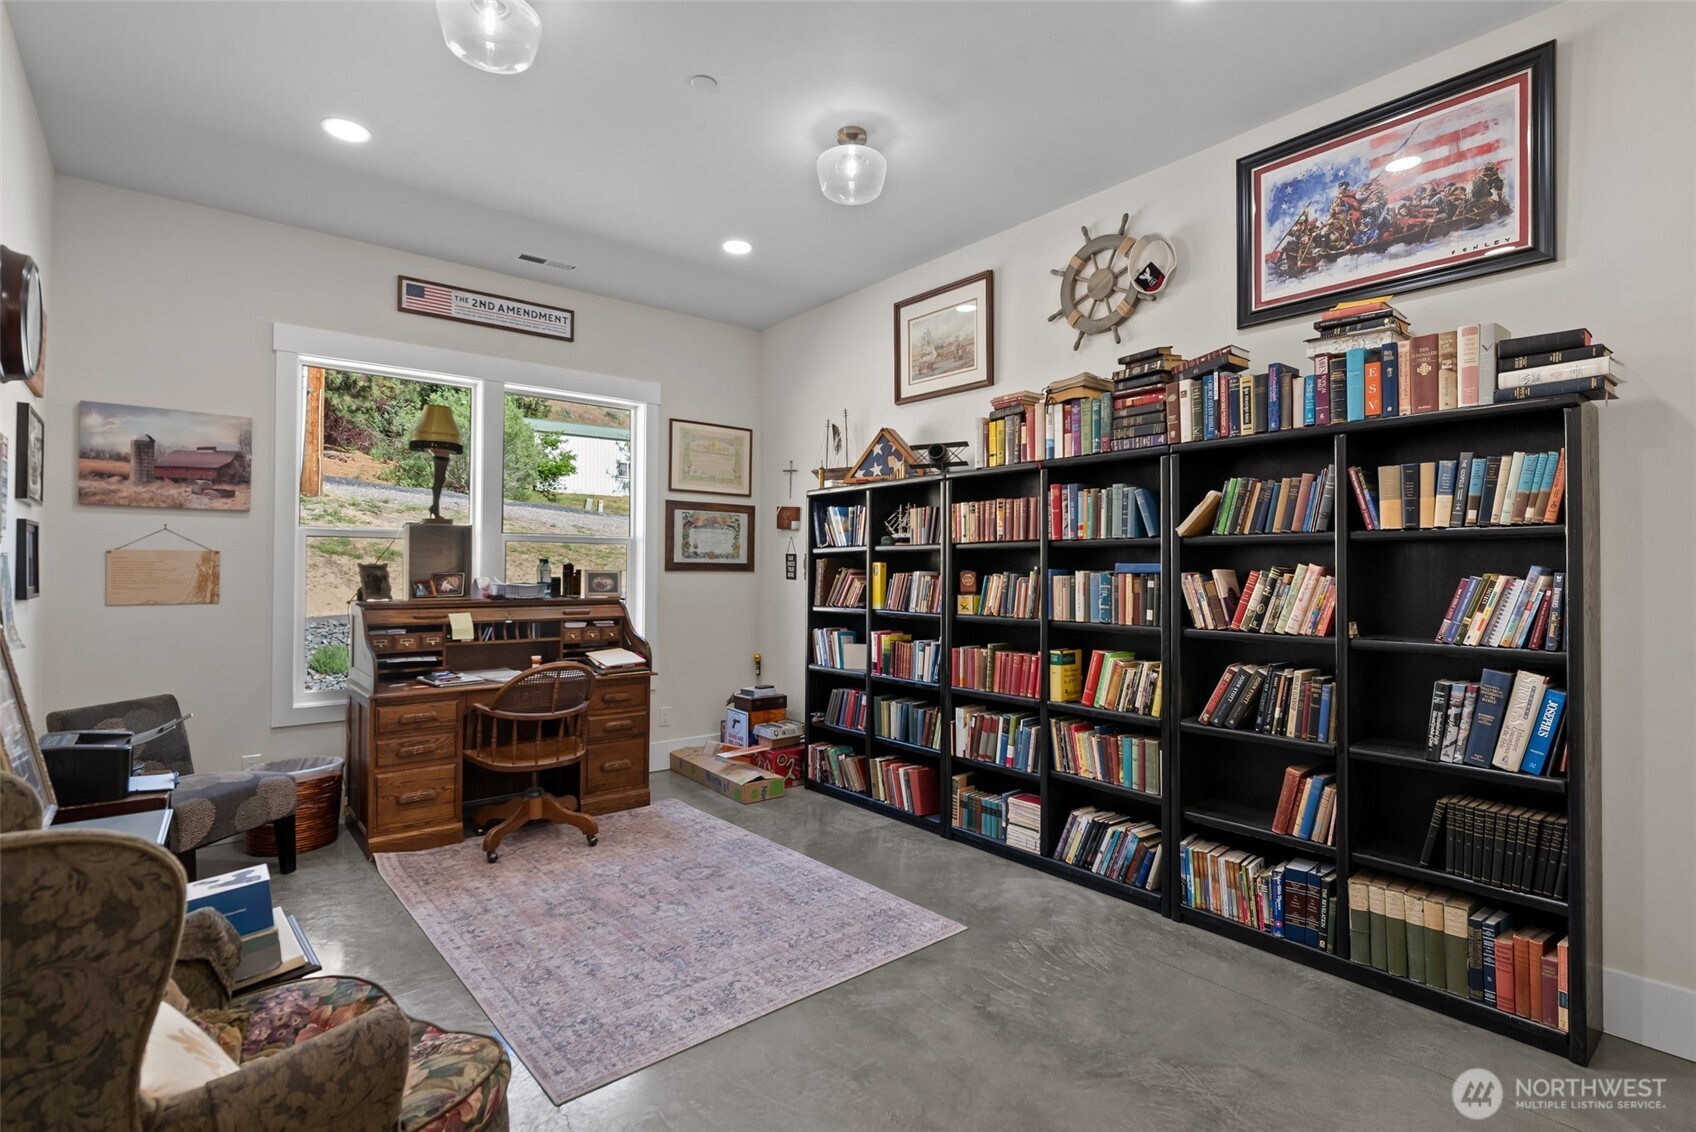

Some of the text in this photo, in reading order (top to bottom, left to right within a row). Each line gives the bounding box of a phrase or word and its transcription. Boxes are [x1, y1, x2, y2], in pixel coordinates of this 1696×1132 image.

[1451, 238, 1512, 255] PENLEY
[455, 295, 469, 304] THE
[472, 298, 495, 311] 2ND
[498, 304, 569, 325] AMENDMENT
[1229, 674, 1245, 702] JOHN STOTT
[1244, 676, 1261, 704] JOHN STOTT
[1538, 699, 1558, 737] JOSEPHUS
